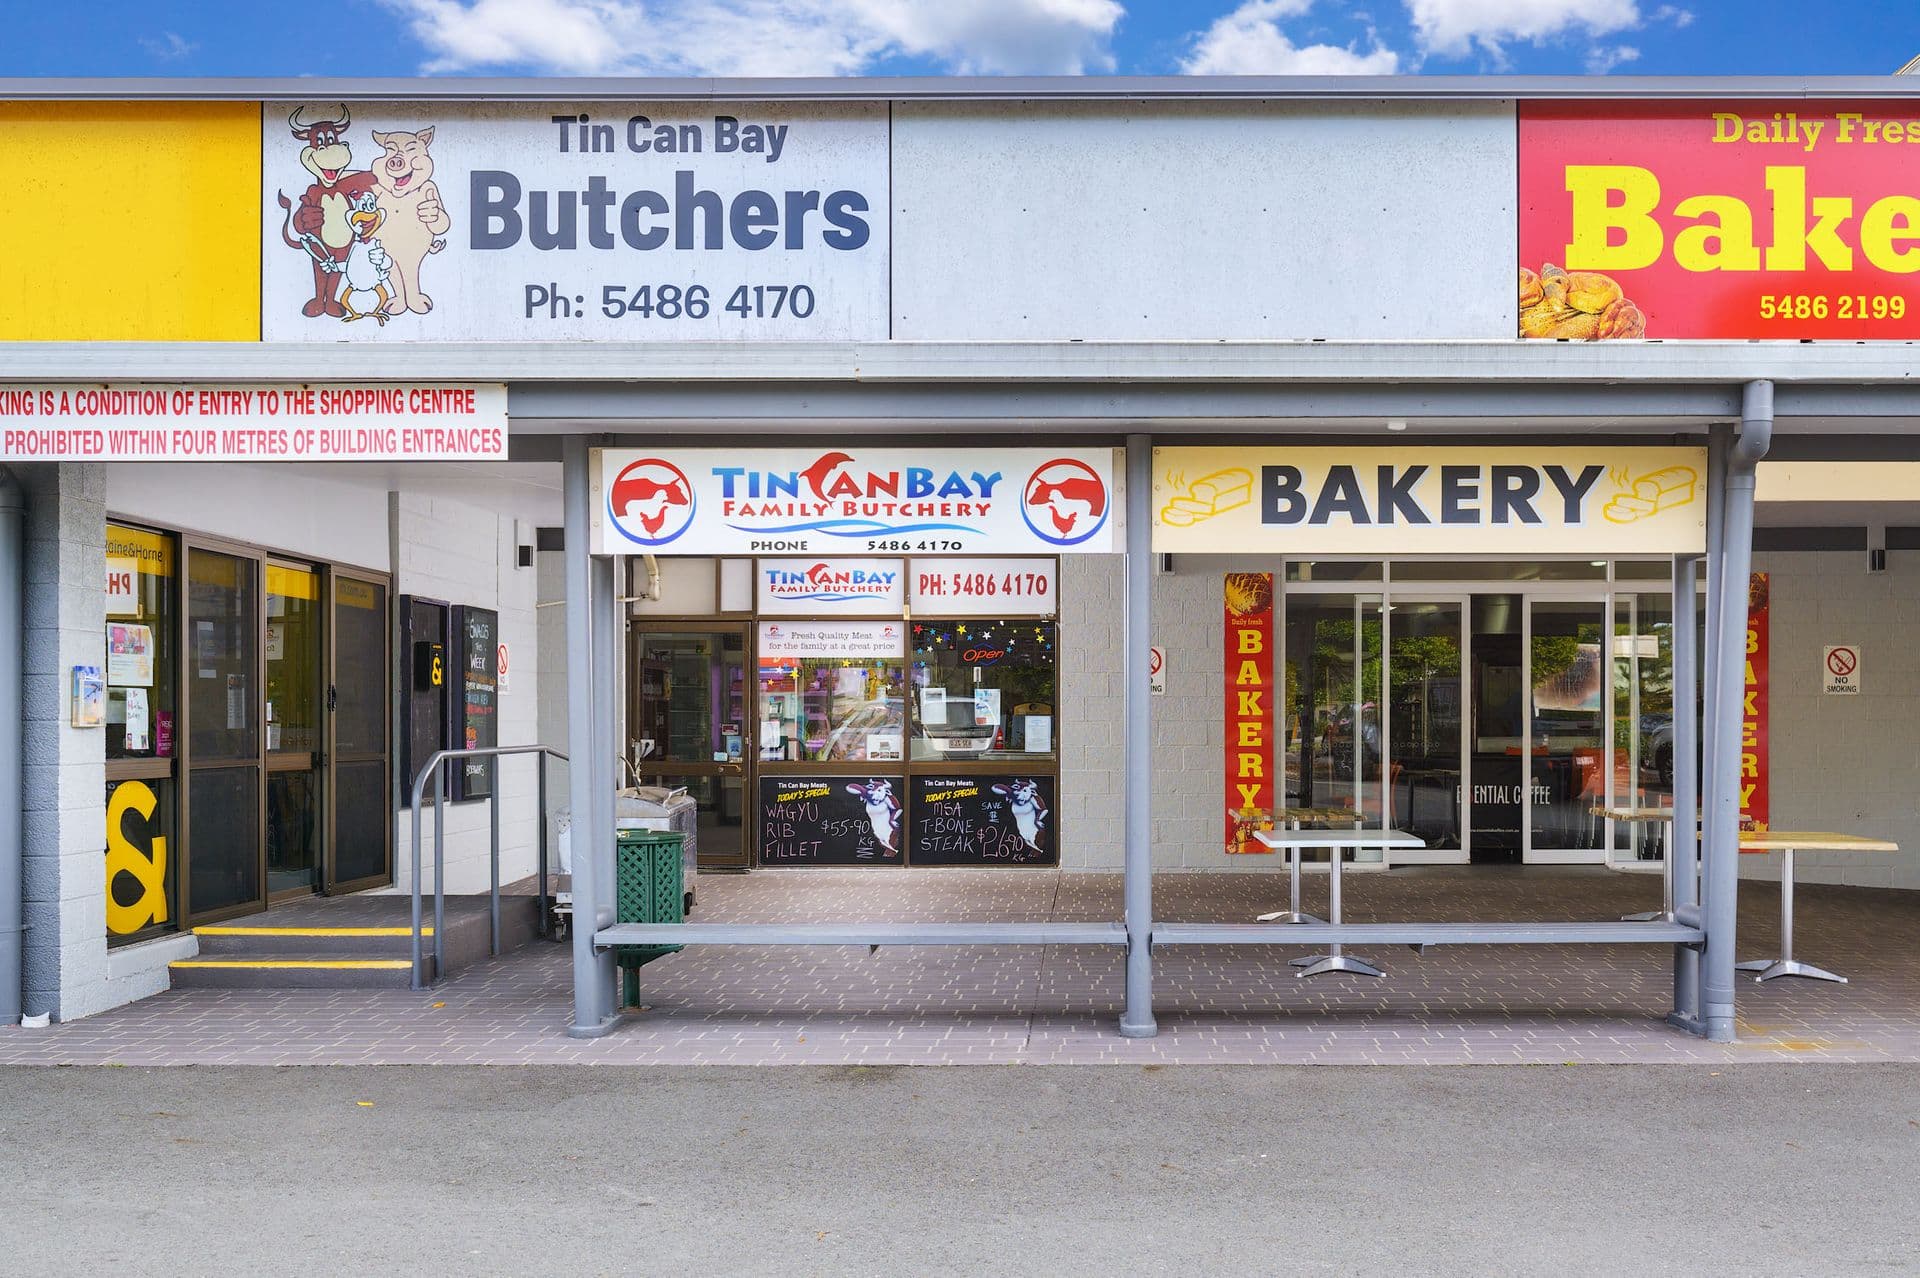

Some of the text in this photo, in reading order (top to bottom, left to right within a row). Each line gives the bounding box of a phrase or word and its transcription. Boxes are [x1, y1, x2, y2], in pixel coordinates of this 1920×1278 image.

[551, 115, 789, 163] Tin Can Bay
[1711, 112, 1825, 152] Daily
[470, 170, 870, 251] Butchers
[1565, 165, 1920, 273] Bake
[525, 283, 815, 319] Ph: 5486 4170
[1760, 295, 1905, 319] 5486 2199
[39, 390, 55, 415] IS
[59, 391, 71, 415] A
[75, 390, 168, 416] CONDITION
[172, 390, 195, 415] OF
[199, 390, 251, 415] ENTRY
[256, 390, 279, 415] TO
[284, 390, 316, 414] THE
[320, 389, 405, 414] SHOPPING
[408, 389, 475, 414] CENTRE
[5, 429, 502, 455] PROHIBITED WITHIN FOUR METRES OF BUILDING ENTRANCES
[1261, 465, 1605, 526] BAKERY
[723, 501, 992, 518] FAMILY BUTCHERY
[751, 540, 963, 551] PHONE 5486 4170
[770, 585, 891, 593] FAMILY BUTCHERY
[920, 573, 1047, 596] PH: 5486 4170
[1231, 617, 1263, 626] Daily fresh
[791, 632, 816, 640] Fresh
[818, 632, 849, 641] Quality
[852, 632, 873, 640] Meat
[769, 642, 781, 650] for
[784, 642, 798, 650] the
[800, 642, 826, 651] family
[849, 643, 870, 652] great
[873, 643, 895, 652] price
[963, 649, 1005, 662] Open
[1826, 685, 1857, 693] SMOKING
[1236, 629, 1263, 809] BAKERY
[799, 782, 810, 790] Bay
[946, 780, 956, 789] Bay
[777, 787, 831, 802] TODAY'S SPECIAL
[925, 787, 978, 803] TODAY'S SPECIAL
[1456, 785, 1510, 804] EENTIAL
[766, 803, 819, 822] WAGYU
[933, 802, 962, 817] MSA
[981, 802, 1003, 811] SAVE
[767, 823, 795, 838] RIB
[920, 817, 974, 834] T-BONE
[767, 840, 822, 858] FILLET
[858, 837, 875, 847] KG
[921, 836, 974, 855] STEAK
[1012, 852, 1025, 862] KG
